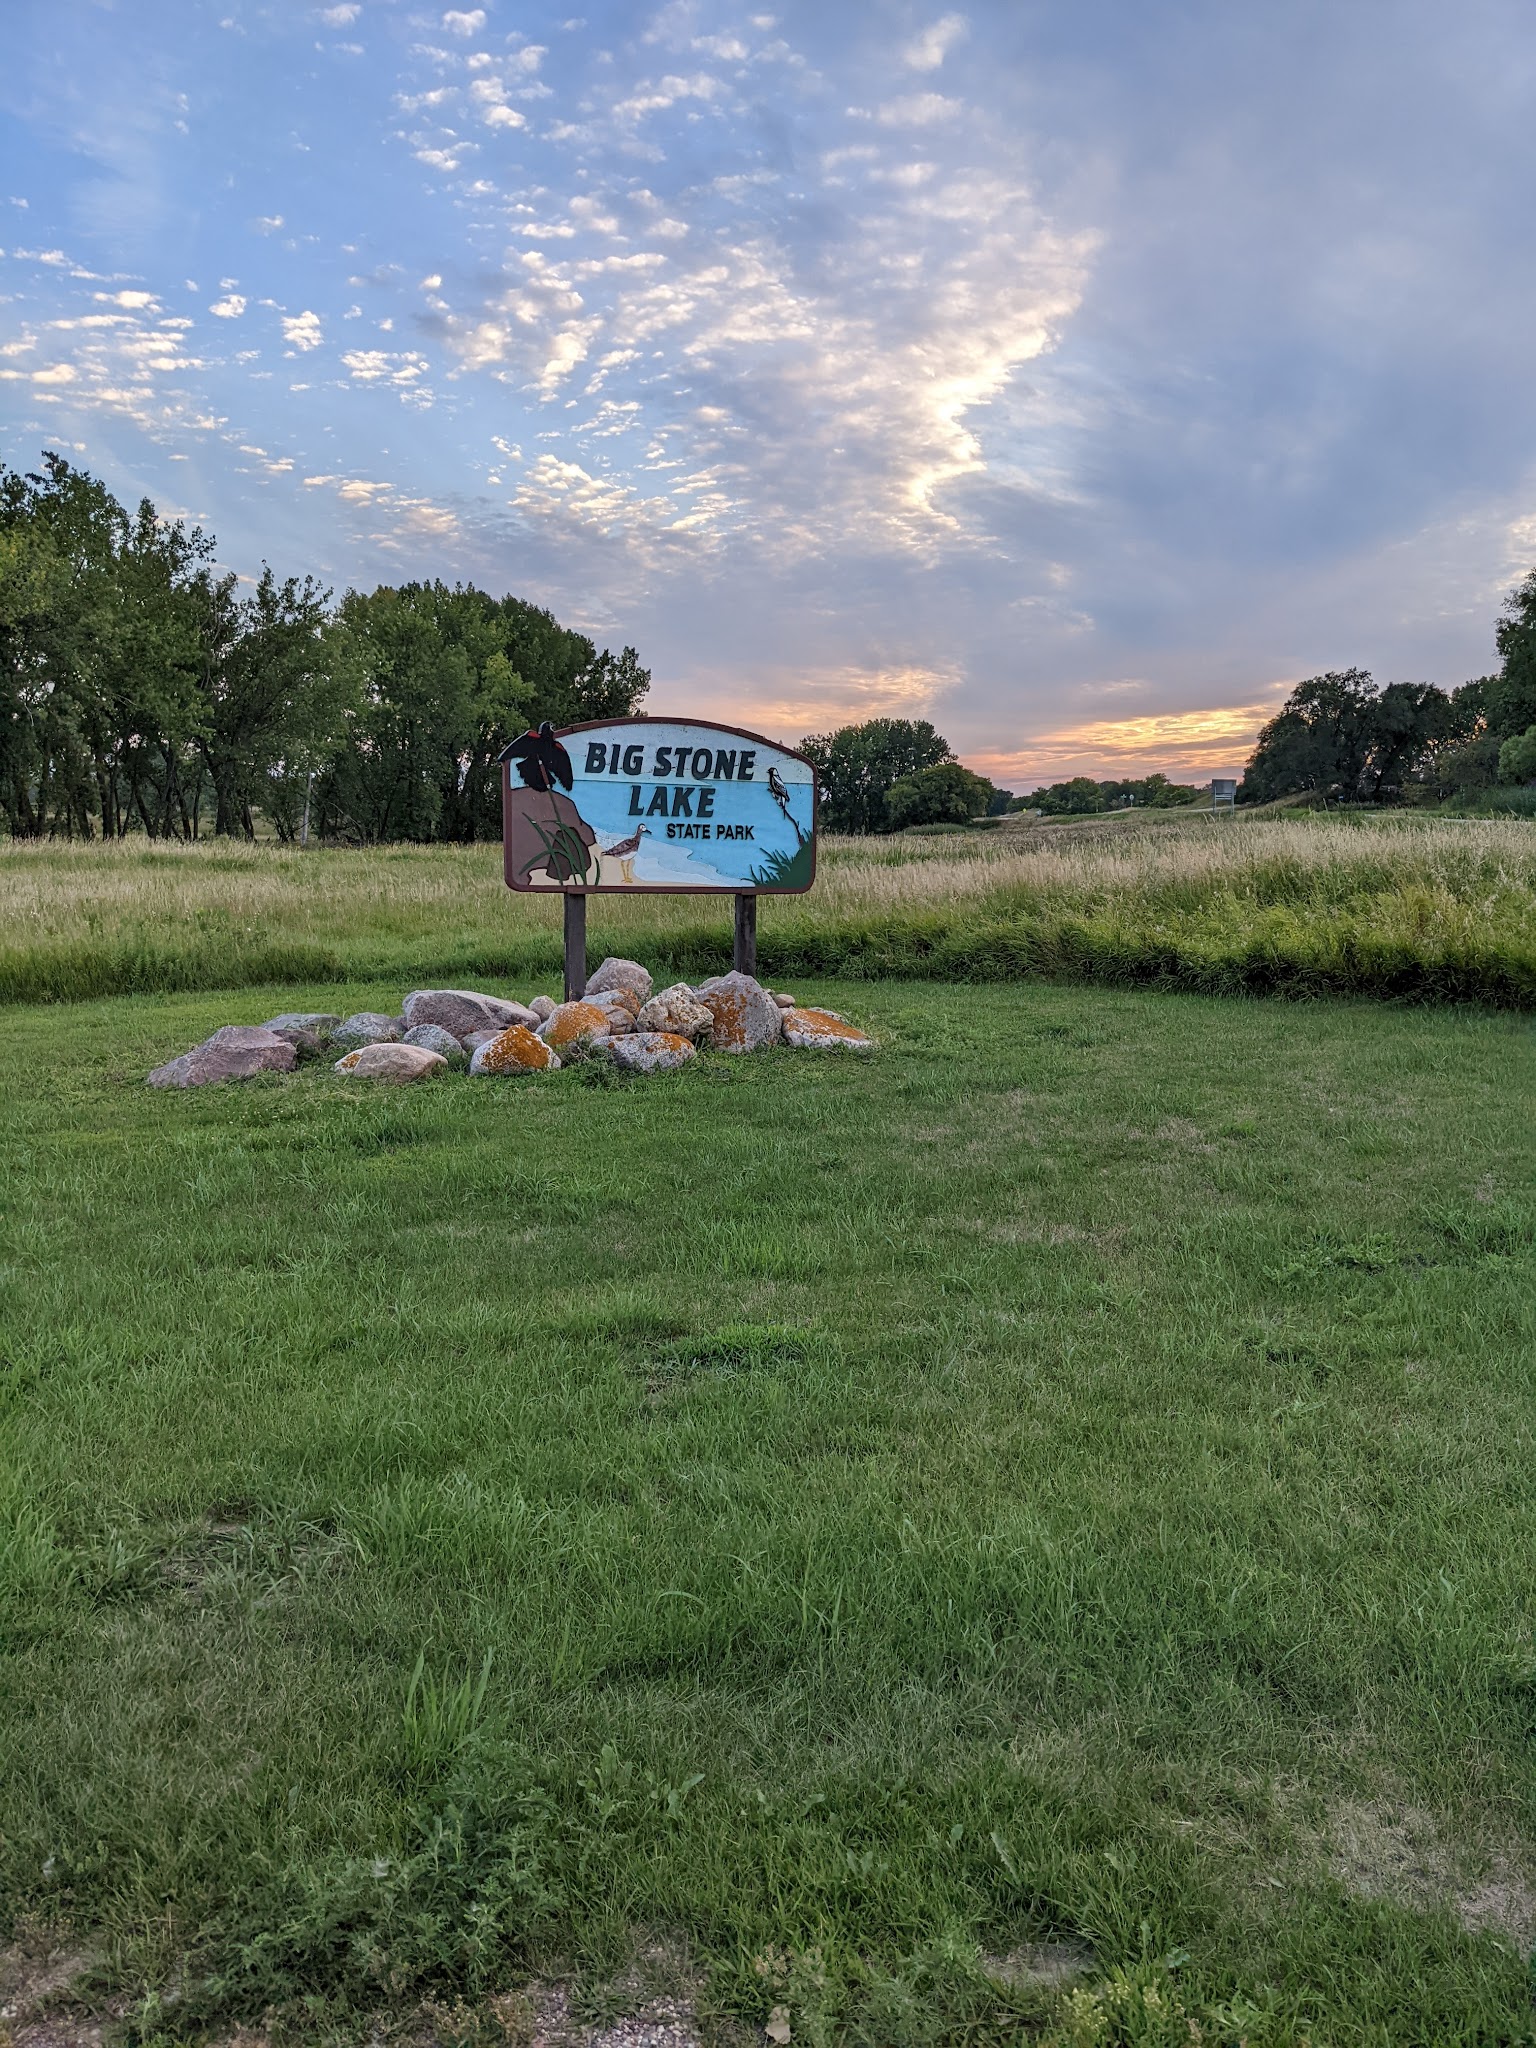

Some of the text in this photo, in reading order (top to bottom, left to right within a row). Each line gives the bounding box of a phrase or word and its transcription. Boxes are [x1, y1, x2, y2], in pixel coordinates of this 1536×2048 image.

[585, 742, 756, 780] BIG STONE
[628, 785, 716, 817] LAKE
[667, 823, 755, 840] STATE PARK
